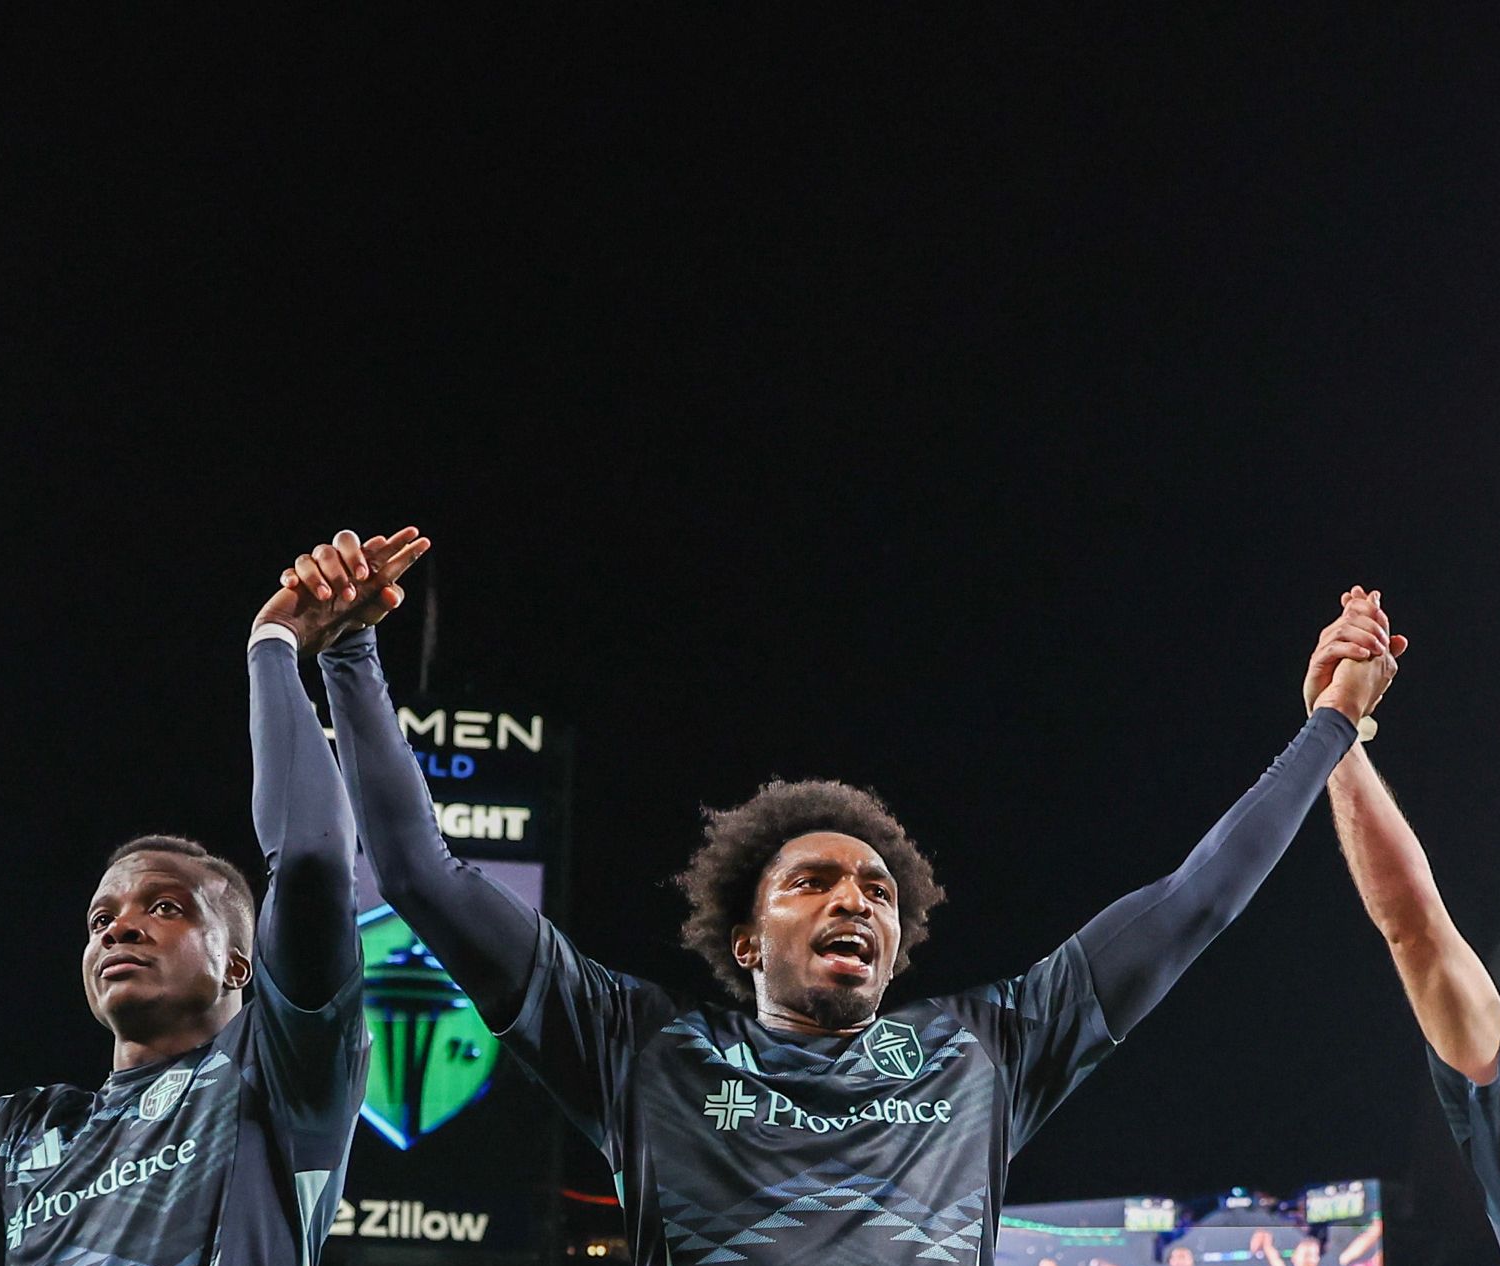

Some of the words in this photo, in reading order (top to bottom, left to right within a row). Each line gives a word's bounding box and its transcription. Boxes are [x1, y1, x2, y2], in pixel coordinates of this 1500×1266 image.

[763, 1090, 952, 1134] Providence
[24, 1138, 197, 1230] Providence
[358, 1200, 489, 1242] Zillow
